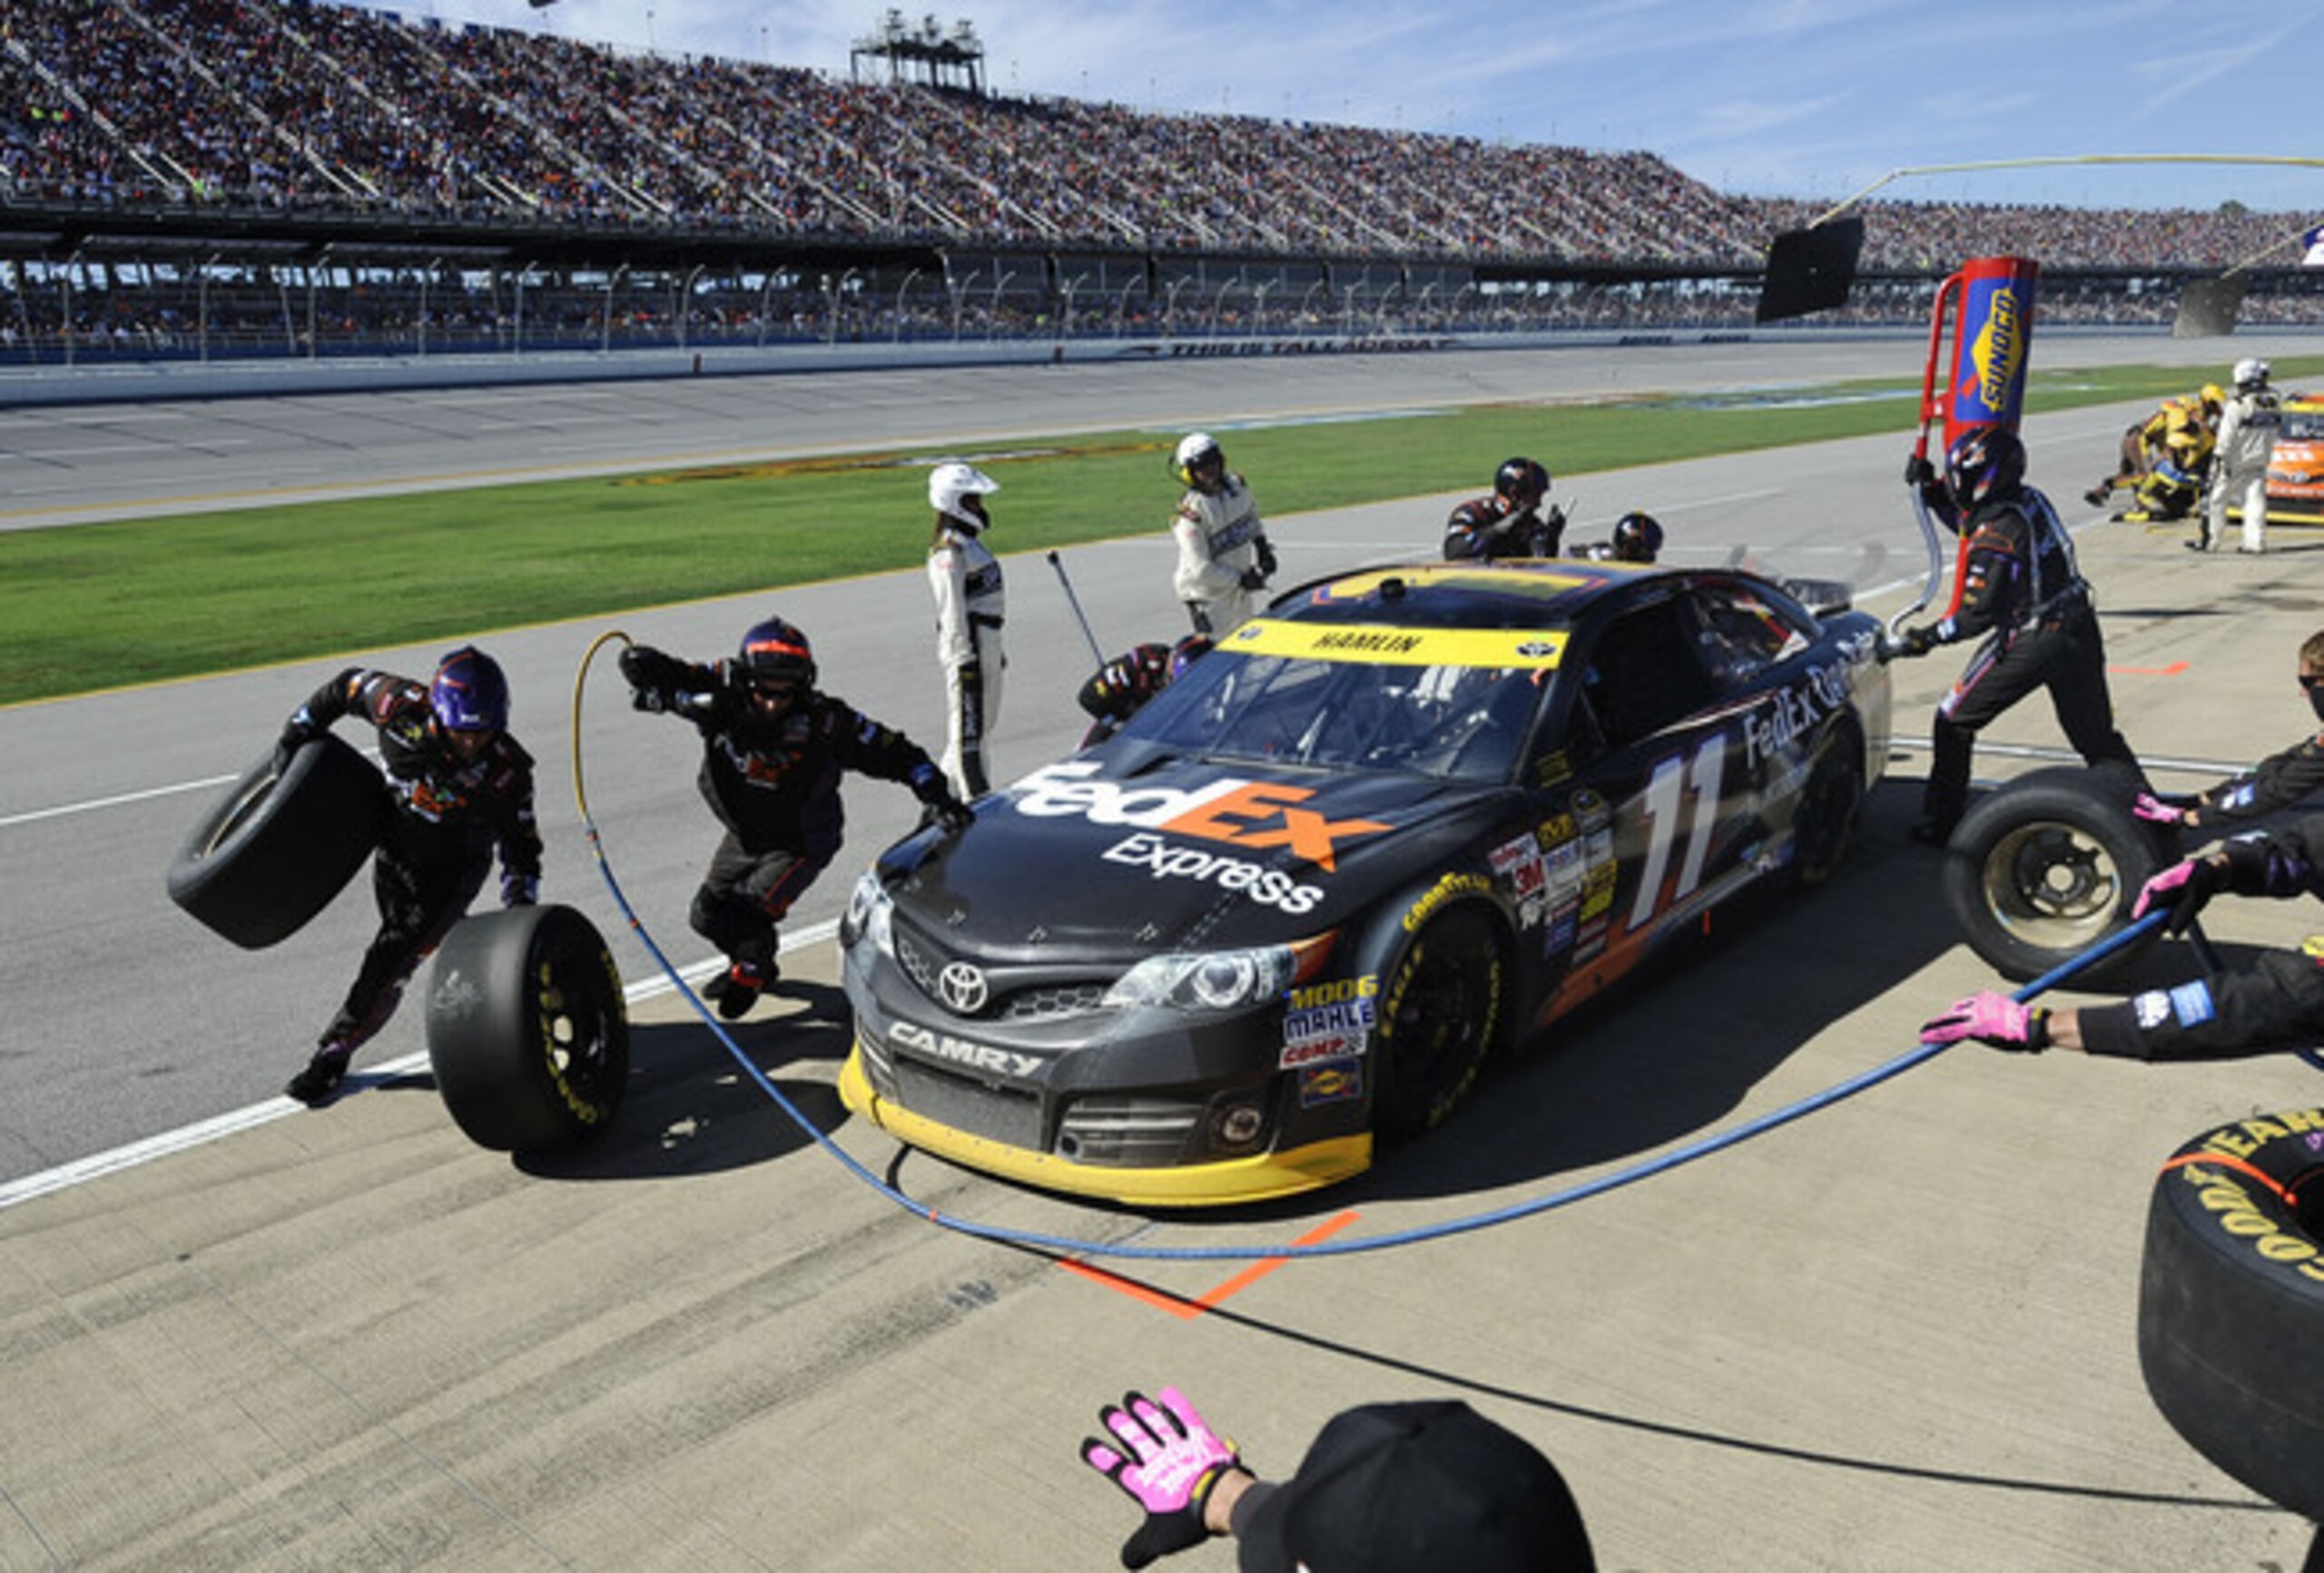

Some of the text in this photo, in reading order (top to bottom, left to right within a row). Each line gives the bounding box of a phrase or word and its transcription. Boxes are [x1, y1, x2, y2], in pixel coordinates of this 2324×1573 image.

[1984, 291, 2016, 407] SUNOCO
[1311, 632, 1423, 654] HAMLIN
[1744, 685, 1823, 770] FedEx
[1009, 761, 1396, 873] FedEx
[1627, 732, 1725, 932] 11
[1101, 831, 1325, 914] Express
[1285, 1000, 1374, 1038] MAHLE
[1287, 974, 1379, 1009] MOOG
[888, 1020, 1043, 1077] CAMRY
